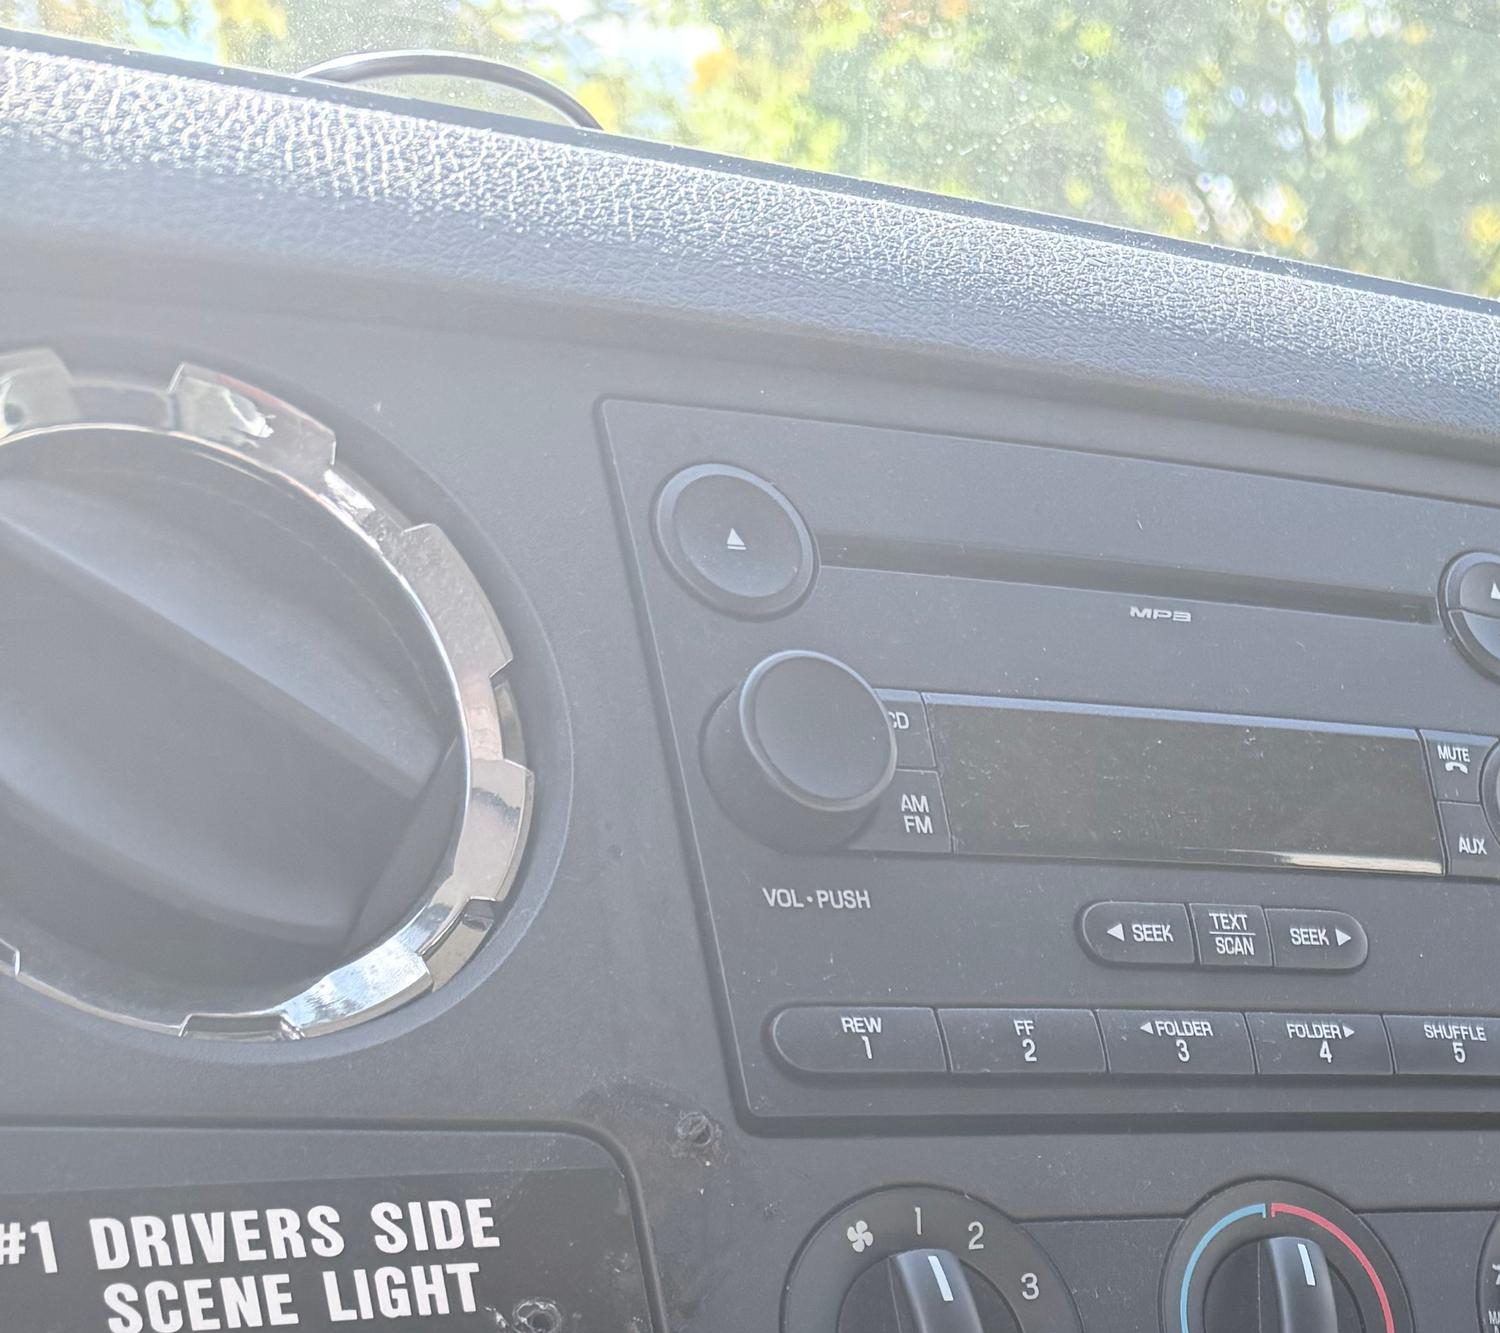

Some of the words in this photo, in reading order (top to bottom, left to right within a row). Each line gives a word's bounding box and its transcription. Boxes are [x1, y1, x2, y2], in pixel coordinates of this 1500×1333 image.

[1130, 605, 1191, 622] MP3
[1437, 745, 1470, 762] MUTE
[901, 794, 929, 813] AM
[903, 815, 933, 834] FM
[1459, 836, 1487, 855] AUX
[1208, 913, 1248, 931] TEXT
[1132, 924, 1174, 943] SEEK
[1290, 928, 1330, 946] SEEK
[1215, 936, 1254, 956] SCAN
[841, 1016, 882, 1033] REW
[1014, 1019, 1034, 1036] FF
[1156, 1020, 1214, 1037] FOLDER
[1287, 1023, 1344, 1041] FOLDER
[1424, 1024, 1488, 1043] SHUFFLE
[861, 1036, 873, 1059] 1
[1022, 1039, 1037, 1062] 2
[1176, 1039, 1190, 1062] 3
[1319, 1041, 1333, 1064] 4
[1453, 1042, 1466, 1064] 5
[914, 1207, 922, 1235] 1
[0, 1219, 57, 1273] #1
[89, 1205, 344, 1270] DRIVERS
[373, 1199, 500, 1254] SIDE
[968, 1221, 984, 1250] 2
[323, 1263, 480, 1322] LIGHT
[1021, 1273, 1039, 1300] 3
